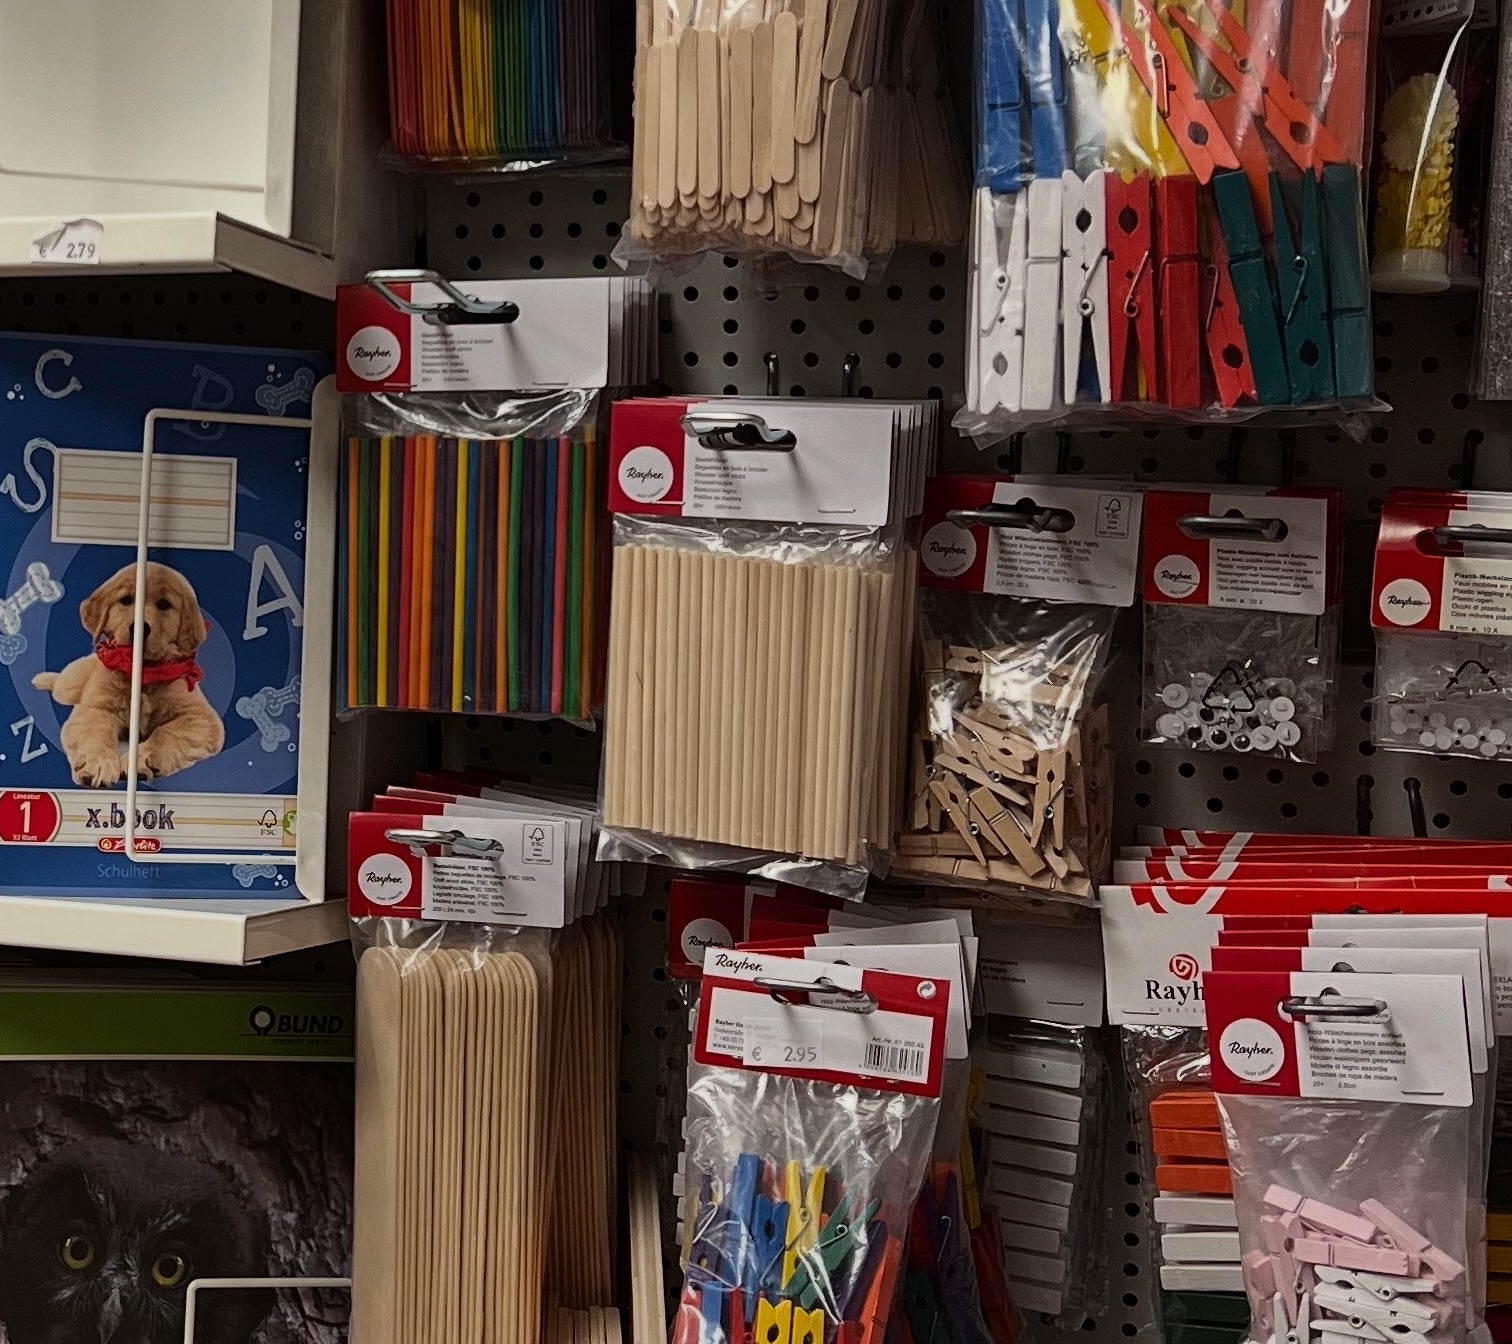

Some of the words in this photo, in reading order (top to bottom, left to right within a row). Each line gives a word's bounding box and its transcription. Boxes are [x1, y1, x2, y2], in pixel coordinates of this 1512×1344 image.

[20, 801, 31, 833] 1
[97, 863, 161, 879] Schulheft
[277, 1014, 344, 1034] BUND
[783, 1046, 817, 1062] 2.95
